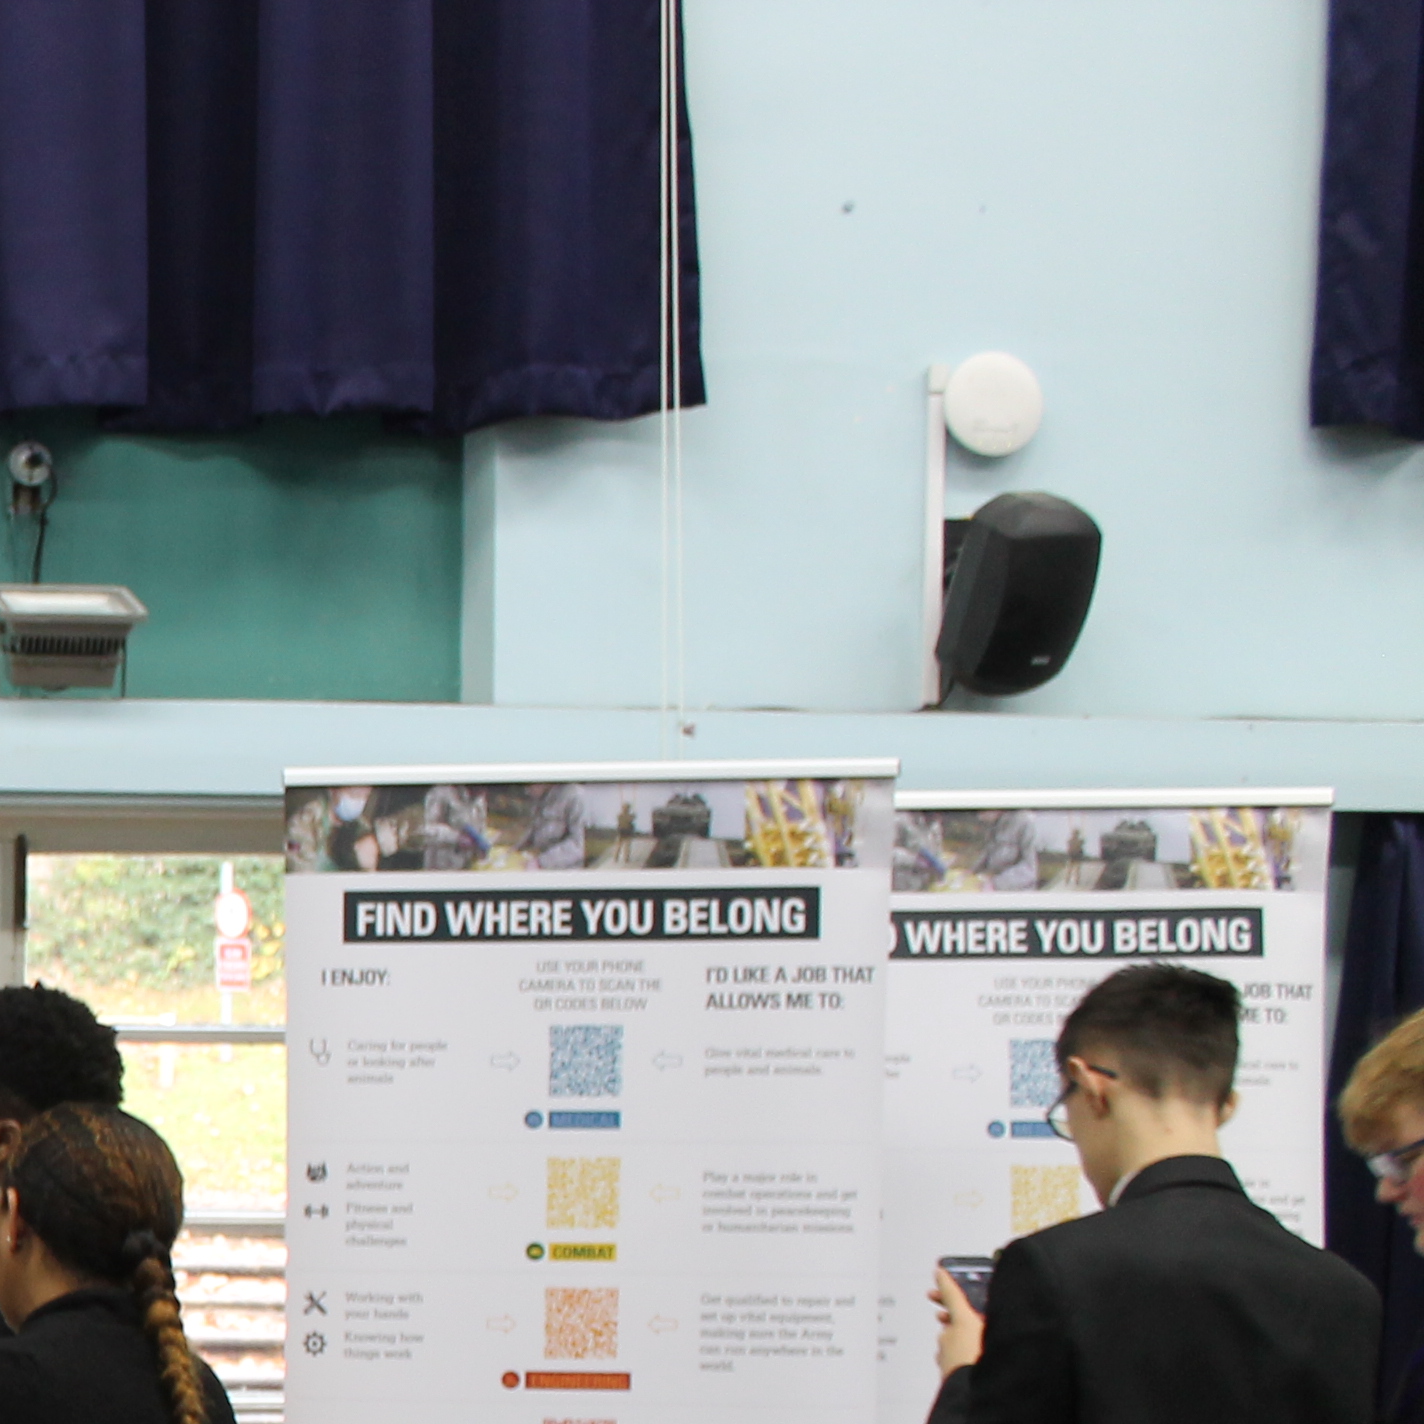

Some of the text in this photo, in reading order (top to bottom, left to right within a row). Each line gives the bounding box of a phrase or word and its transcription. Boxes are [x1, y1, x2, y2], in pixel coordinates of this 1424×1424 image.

[356, 897, 806, 937] FIND WHERE YOU BELONG
[904, 920, 1028, 954] WHERE
[1034, 920, 1105, 954] YOU
[1114, 917, 1252, 953] BELONG
[321, 969, 327, 986] I
[705, 966, 875, 984] I'D LIKE A JOB THAT
[705, 992, 781, 1010] ALLOWS
[785, 992, 812, 1008] ME
[554, 1244, 614, 1261] COMBAT
